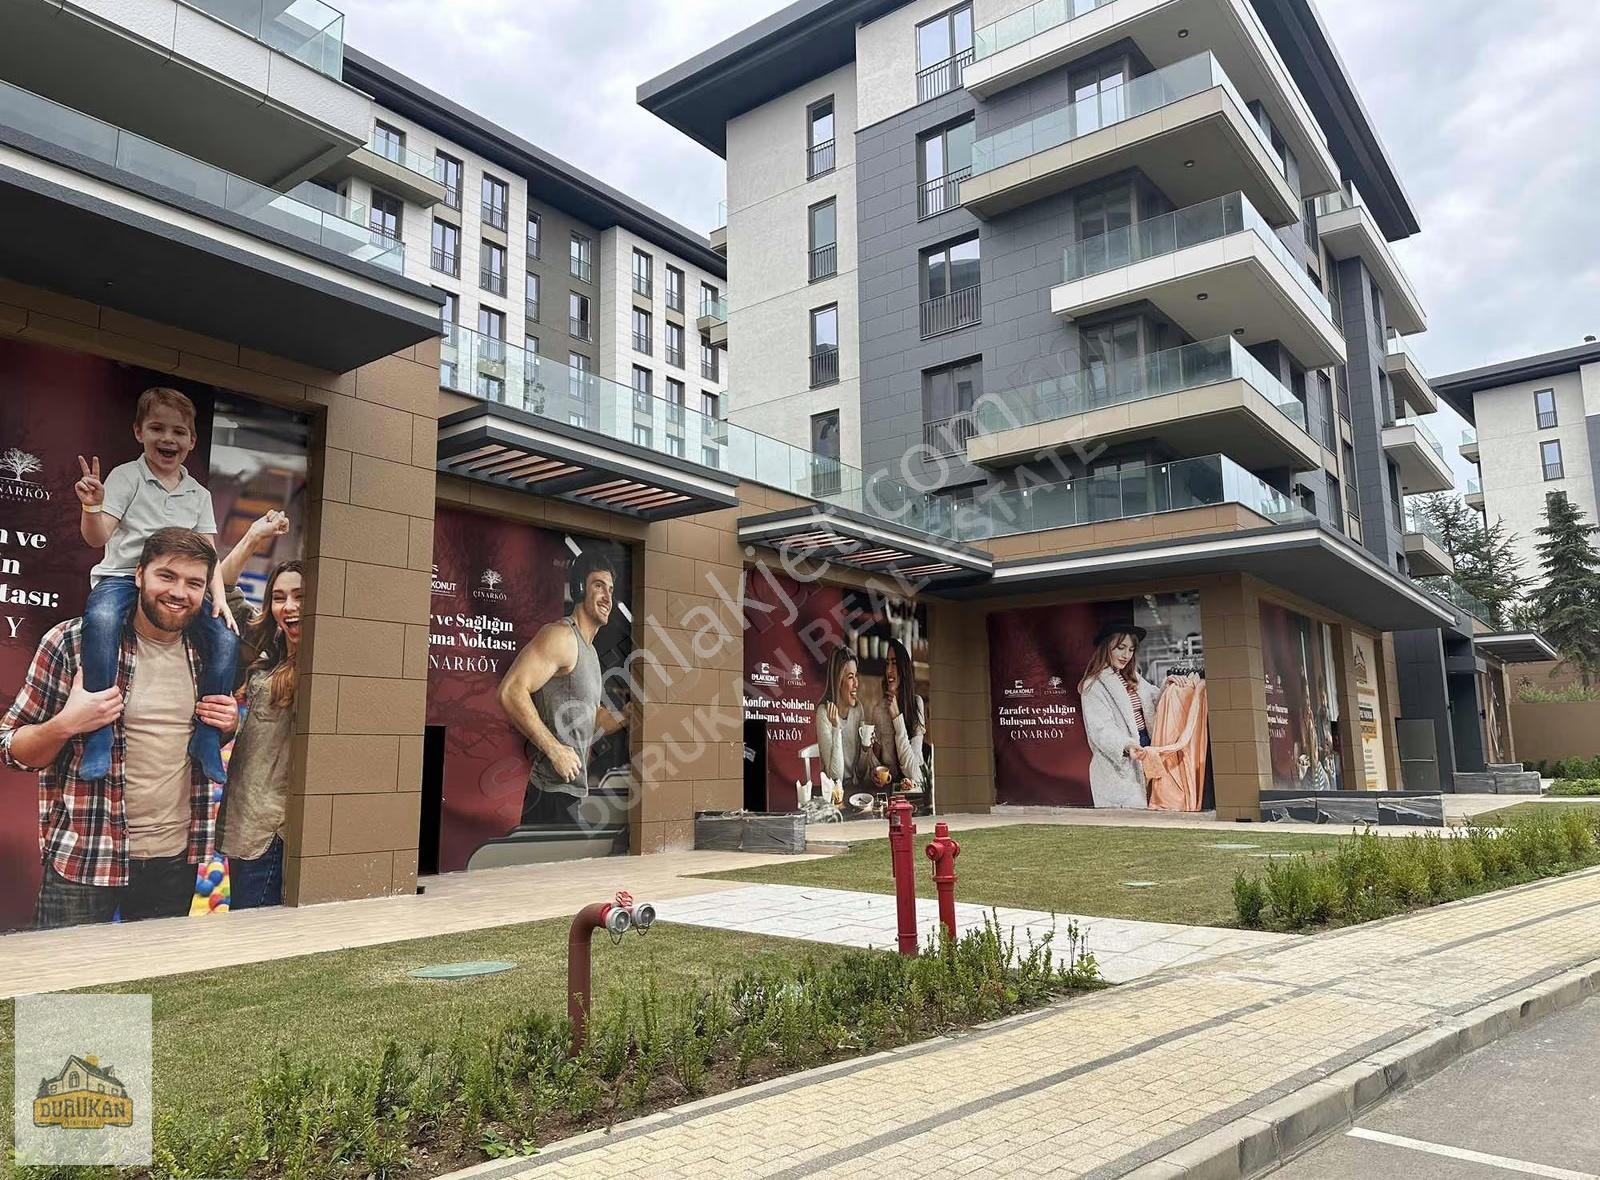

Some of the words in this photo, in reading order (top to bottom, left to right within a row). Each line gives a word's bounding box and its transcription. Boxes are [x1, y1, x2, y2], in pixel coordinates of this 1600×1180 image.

[16, 531, 47, 549] ve
[436, 615, 454, 626] ve
[456, 612, 514, 635] Sağlığın
[459, 632, 517, 651] Noktası:
[742, 695, 771, 709] Konfor
[781, 698, 815, 711] Sohbetin
[998, 705, 1030, 715] Zarafet
[1031, 706, 1042, 714] ve
[1042, 704, 1076, 716] şıklığın
[781, 711, 811, 724] Noktası:
[1000, 716, 1037, 728] Buluşma
[1037, 715, 1075, 725] Noktası:
[1010, 728, 1065, 741] ÇINARKÖY
